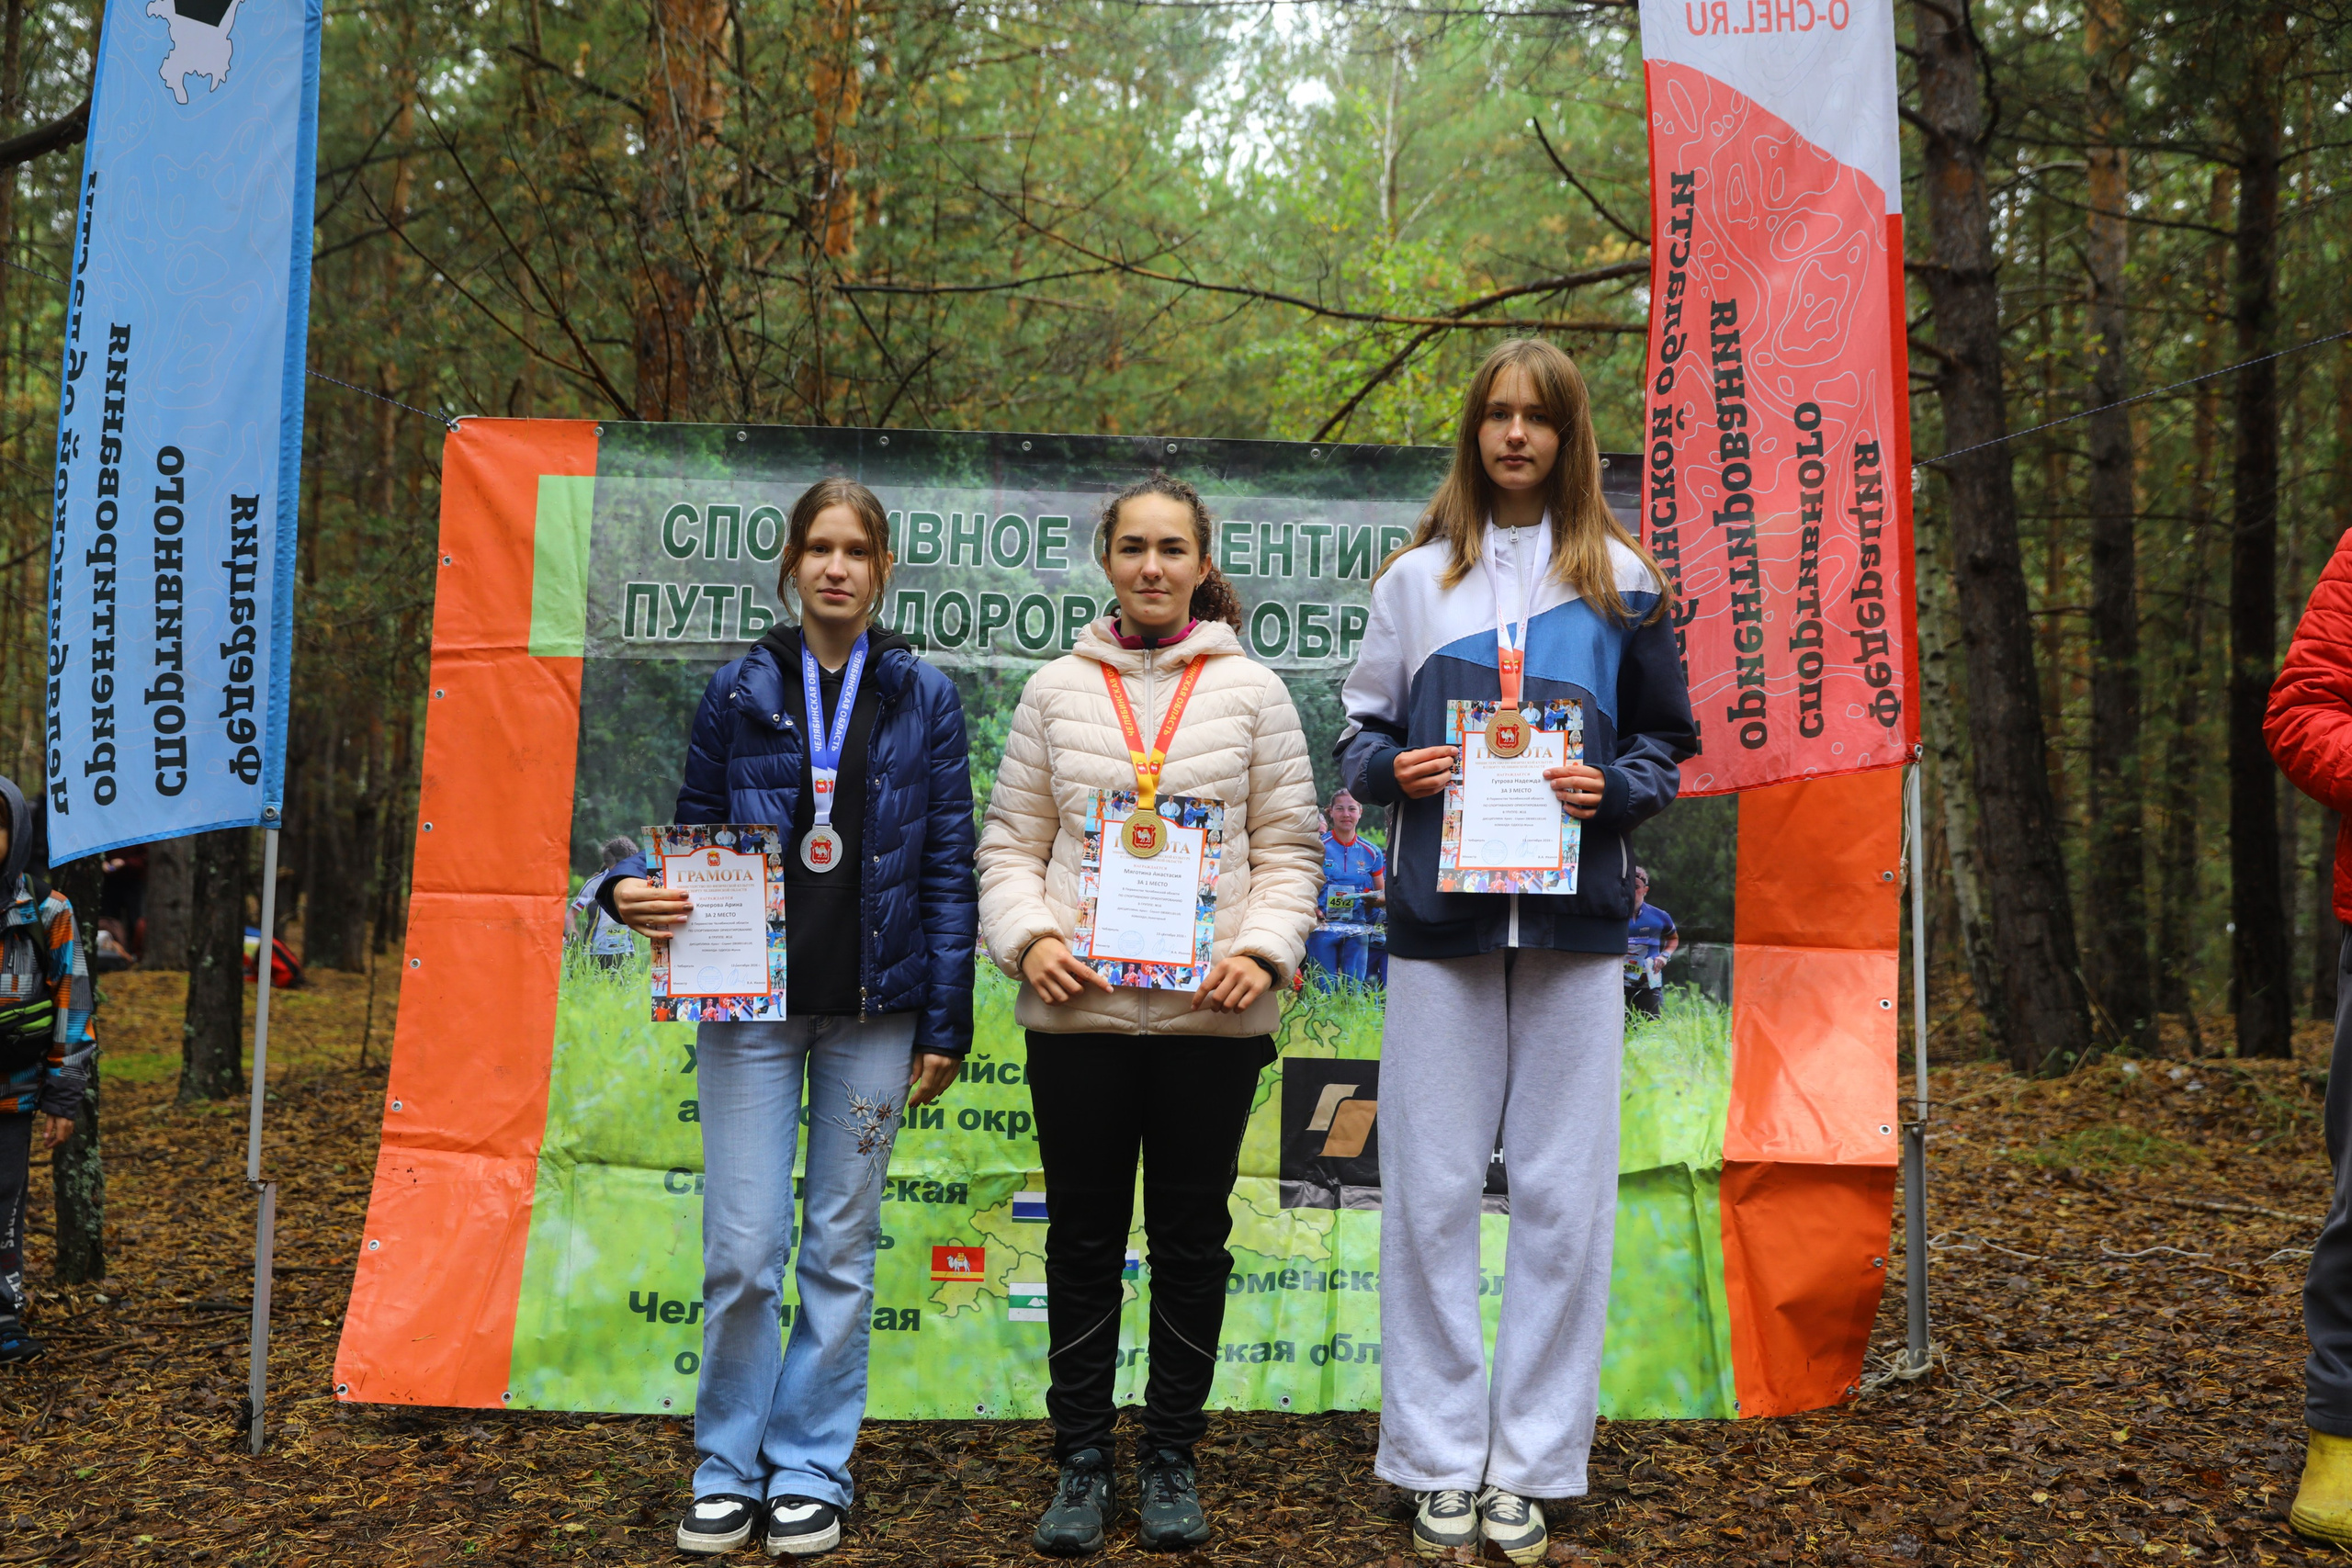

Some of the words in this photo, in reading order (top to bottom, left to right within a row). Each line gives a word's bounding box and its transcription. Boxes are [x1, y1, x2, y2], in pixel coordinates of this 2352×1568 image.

[623, 581, 776, 640] ПУТЬ
[842, 650, 864, 710] ЧЕЛЯБИНСКАЯ
[1109, 678, 1135, 736] ЧЕЛЯБИНСКАЯ
[808, 686, 822, 752] ЧЕЛЯБИНСКАЯ
[831, 710, 847, 751] ОБЛАСТЬ
[1163, 696, 1184, 736] ОБЛАСТЬ
[676, 869, 753, 882] ГРАМОТА
